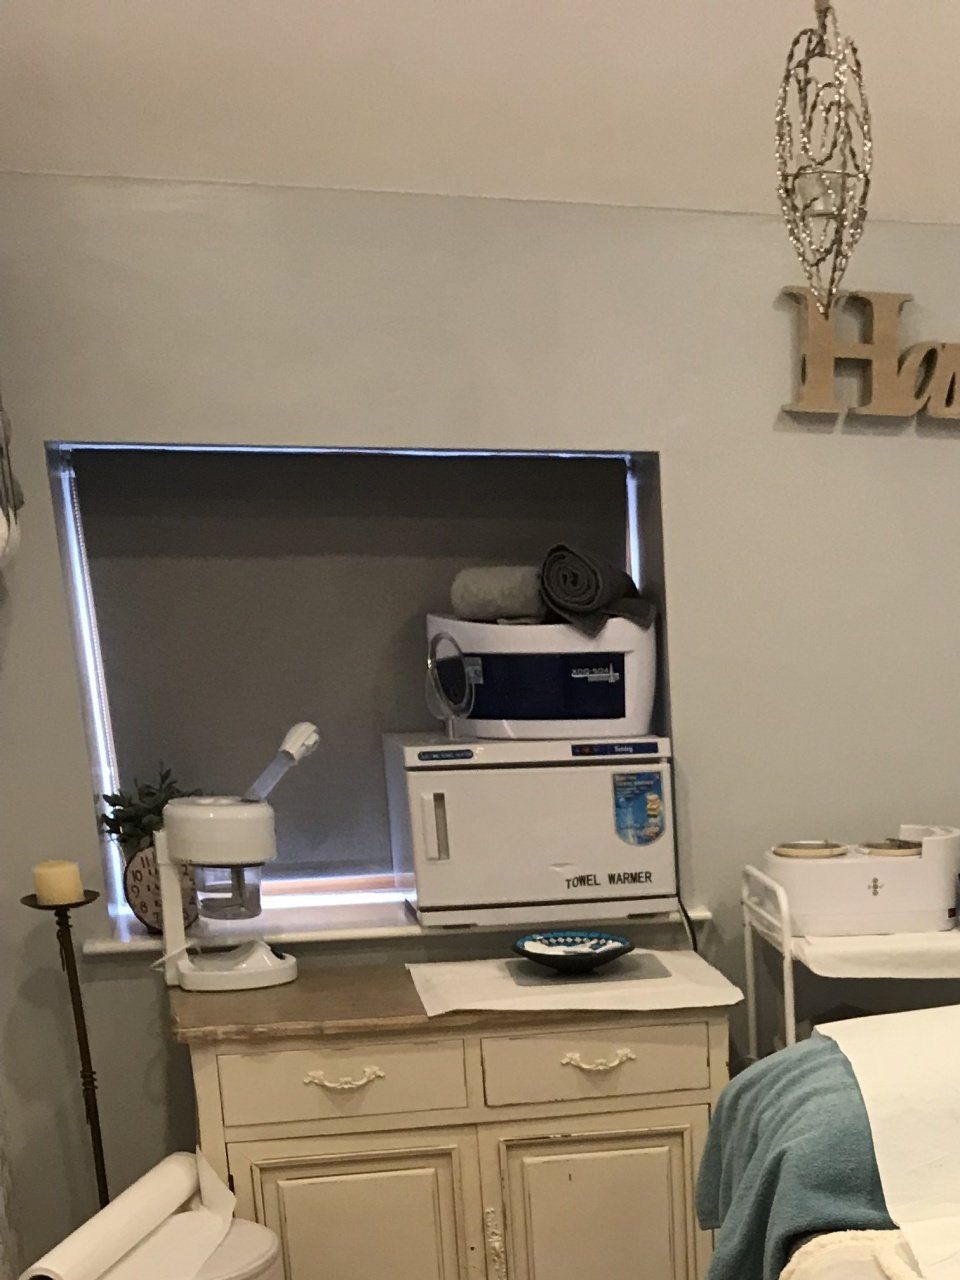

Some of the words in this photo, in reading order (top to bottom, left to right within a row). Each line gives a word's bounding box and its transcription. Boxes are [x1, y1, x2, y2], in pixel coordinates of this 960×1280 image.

[132, 869, 144, 883] 10
[565, 874, 601, 889] TOWEL
[607, 871, 652, 885] WARMER
[131, 885, 140, 898] 9
[140, 901, 149, 914] 8
